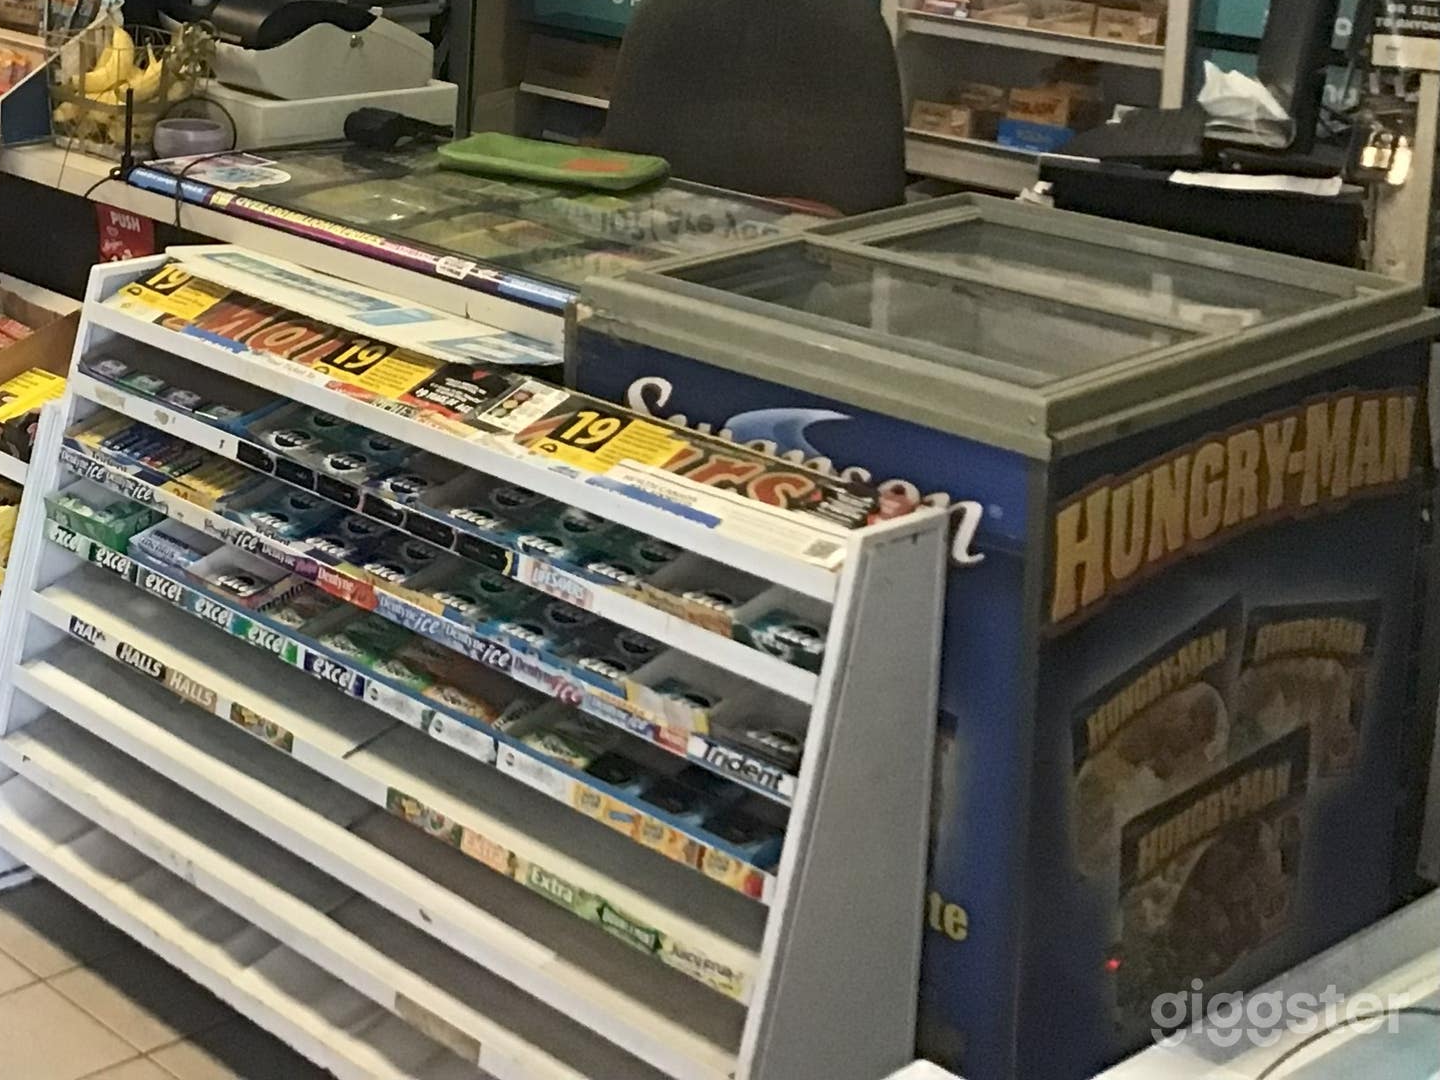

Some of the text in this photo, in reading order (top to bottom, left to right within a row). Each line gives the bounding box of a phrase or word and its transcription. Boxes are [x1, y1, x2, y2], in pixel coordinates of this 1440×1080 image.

[110, 210, 141, 232] PUSH
[332, 338, 387, 373] 19
[560, 410, 623, 446] 19
[1052, 395, 1418, 622] HUNGRY-MAN
[95, 547, 131, 578] excel
[145, 572, 182, 601] excel
[194, 596, 231, 628] excel
[247, 622, 287, 654] excel
[119, 642, 162, 678] HALLS
[312, 655, 355, 690] excel
[168, 668, 214, 705] HALLS
[529, 866, 576, 904] Extra
